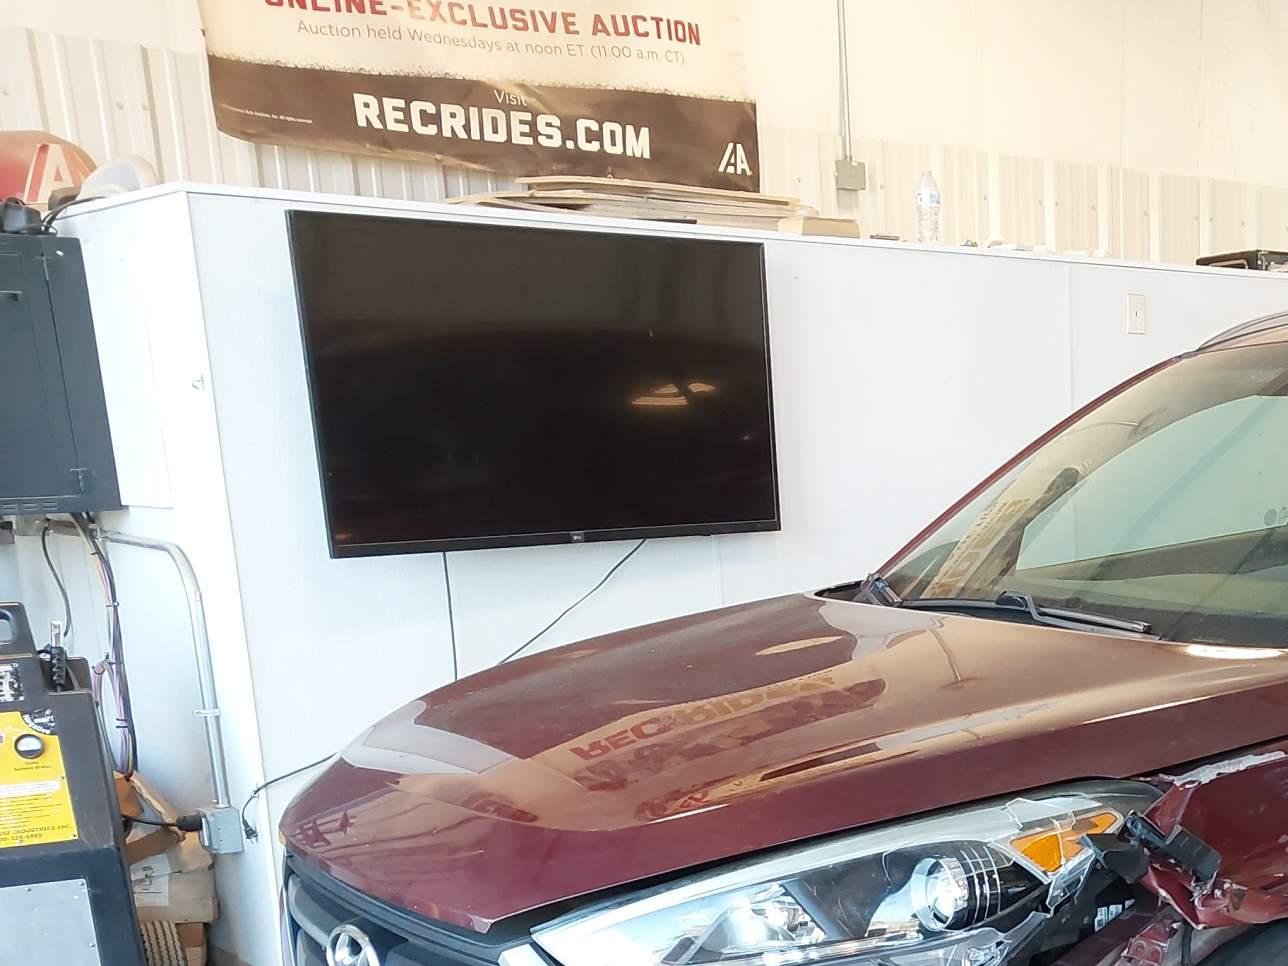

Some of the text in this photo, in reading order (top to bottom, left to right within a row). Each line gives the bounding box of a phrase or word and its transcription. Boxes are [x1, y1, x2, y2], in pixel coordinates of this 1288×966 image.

[265, 0, 701, 46] LINE-EXCLUSIVE AUCTION
[297, 20, 361, 38] Auction
[366, 24, 402, 41] held
[408, 28, 502, 51] Wednesdays
[506, 41, 521, 53] at
[525, 44, 562, 56] noon
[566, 43, 585, 57] ET
[590, 44, 632, 59] (11:00
[636, 50, 661, 62] a.m.
[493, 89, 528, 107] Visit
[352, 92, 651, 159] RECRIDES.COM
